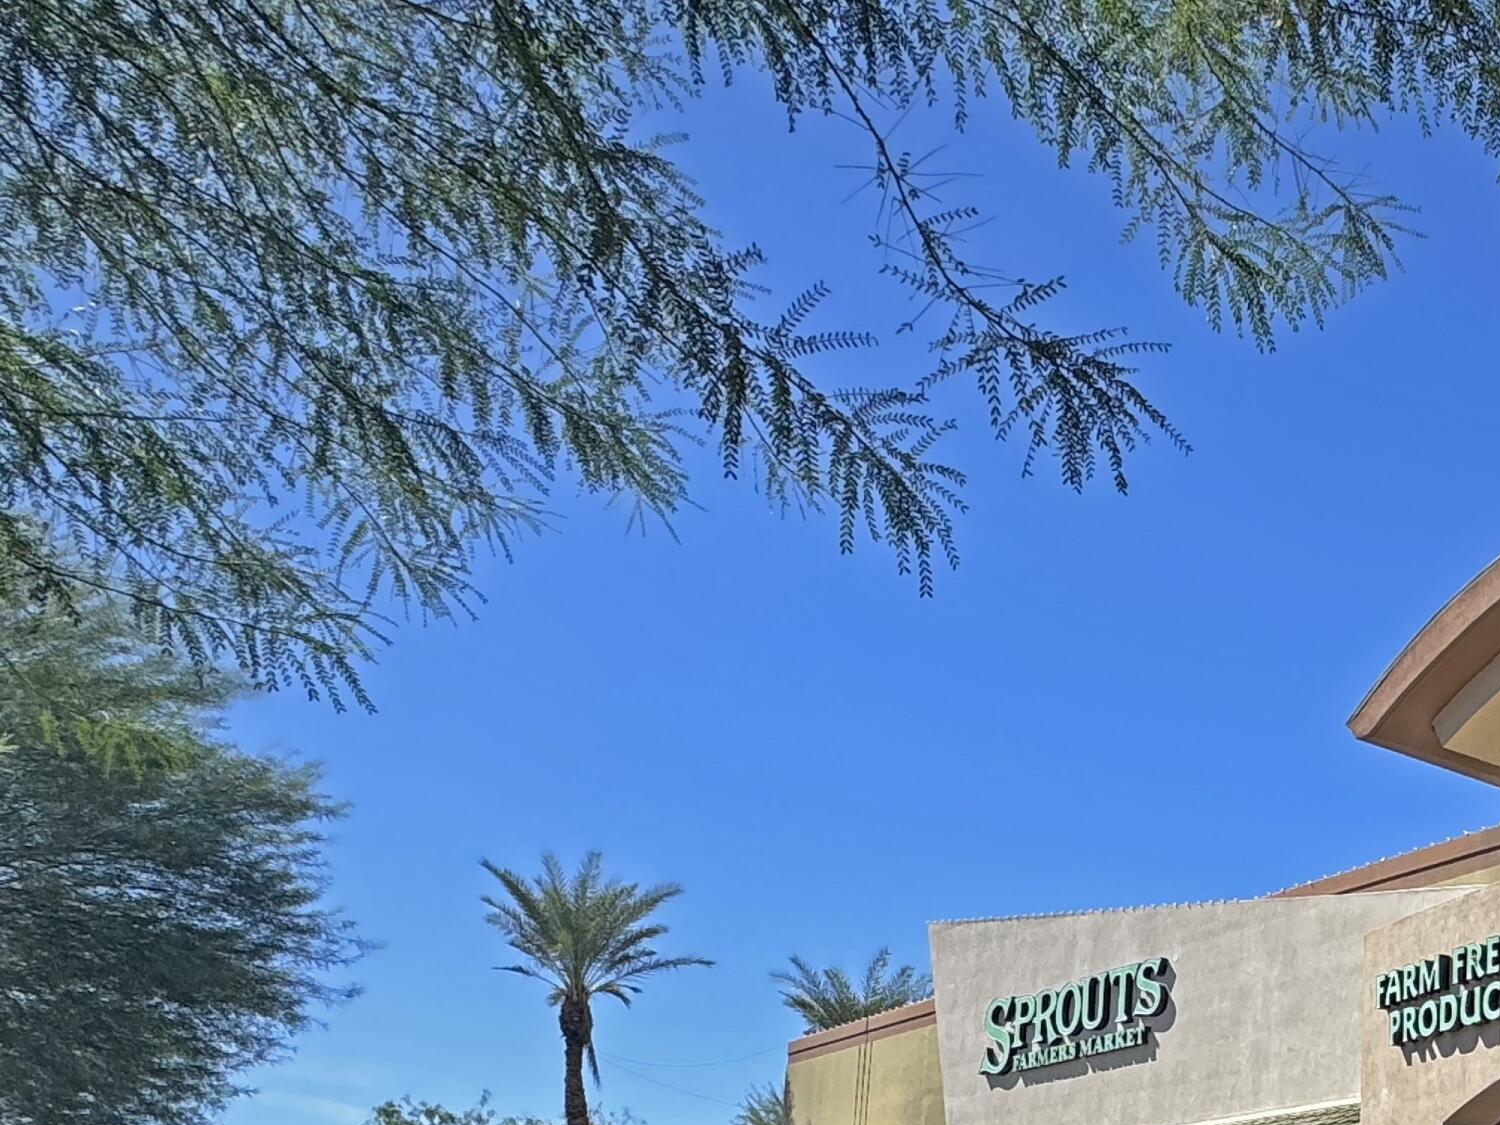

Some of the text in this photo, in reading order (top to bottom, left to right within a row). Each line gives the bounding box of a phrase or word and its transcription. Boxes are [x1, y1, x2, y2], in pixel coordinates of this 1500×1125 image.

[1376, 954, 1445, 1010] FARM
[978, 957, 1168, 1075] SPROUTS
[1012, 1026, 1151, 1072] FARMERS MARKET
